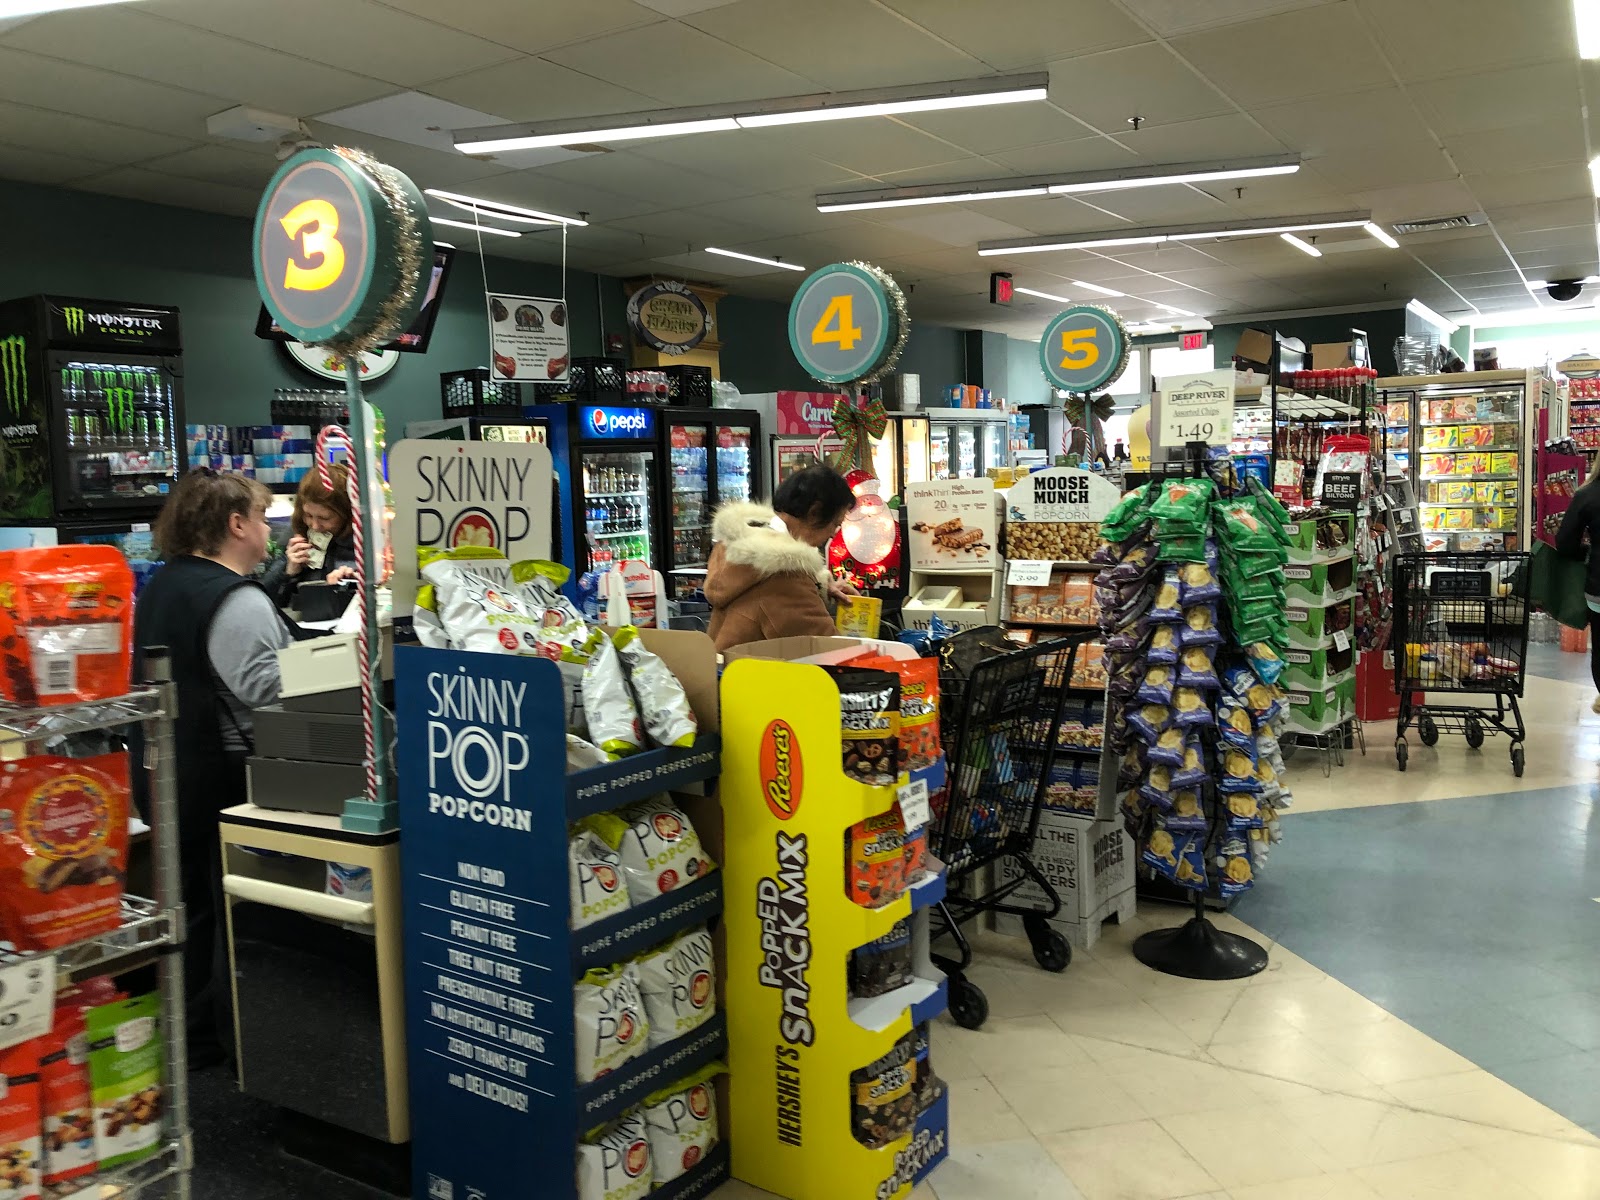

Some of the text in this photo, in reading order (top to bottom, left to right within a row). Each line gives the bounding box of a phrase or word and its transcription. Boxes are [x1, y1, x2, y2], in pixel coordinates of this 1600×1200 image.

[279, 199, 345, 291] 3
[88, 313, 162, 330] MONSTER
[100, 326, 152, 336] ENERGY
[811, 295, 862, 351] 4
[1059, 327, 1099, 370] 5
[1183, 333, 1203, 350] EXIT
[802, 402, 833, 422] Carve
[1172, 390, 1225, 402] DEEP RIVER
[1201, 406, 1219, 416] Chips
[610, 413, 646, 433] pepsi
[1170, 422, 1214, 441] $1.49
[416, 450, 532, 502] SKINNY
[1034, 476, 1089, 490] MOOSE
[1325, 484, 1356, 493] BEEF
[934, 500, 947, 509] 20
[1034, 490, 1089, 504] MUNCH
[1034, 511, 1089, 520] POPCORN
[1287, 612, 1307, 620] NYDERS
[427, 666, 527, 728] SKINNY
[841, 719, 868, 730] ACK
[428, 720, 530, 802] POP
[576, 751, 715, 800] PURE POPPED PERFECTION
[767, 724, 793, 813] Reese's
[428, 792, 532, 832] POPCORN
[1048, 829, 1076, 844] THE
[457, 861, 506, 888] NON GMO
[450, 889, 516, 921] GLUTEN FREE
[581, 889, 719, 956] PURE POPPED PERFECTION
[450, 919, 517, 953] PEANUT FREE
[758, 877, 786, 986] POPPED
[777, 830, 815, 1047] SnACK MIX
[447, 948, 522, 985] TREE NUT FREE
[437, 974, 535, 1020] PRESERVATIVE FREE
[430, 1001, 546, 1053] NO ARTIFICIAL FLAVORS
[447, 1036, 528, 1078] ZERO TRANS FAT
[585, 1029, 721, 1112] PURE POPPED PERFECTION
[464, 1073, 529, 1113] DELICIOUS!
[776, 1044, 802, 1147] HERSHEY'S
